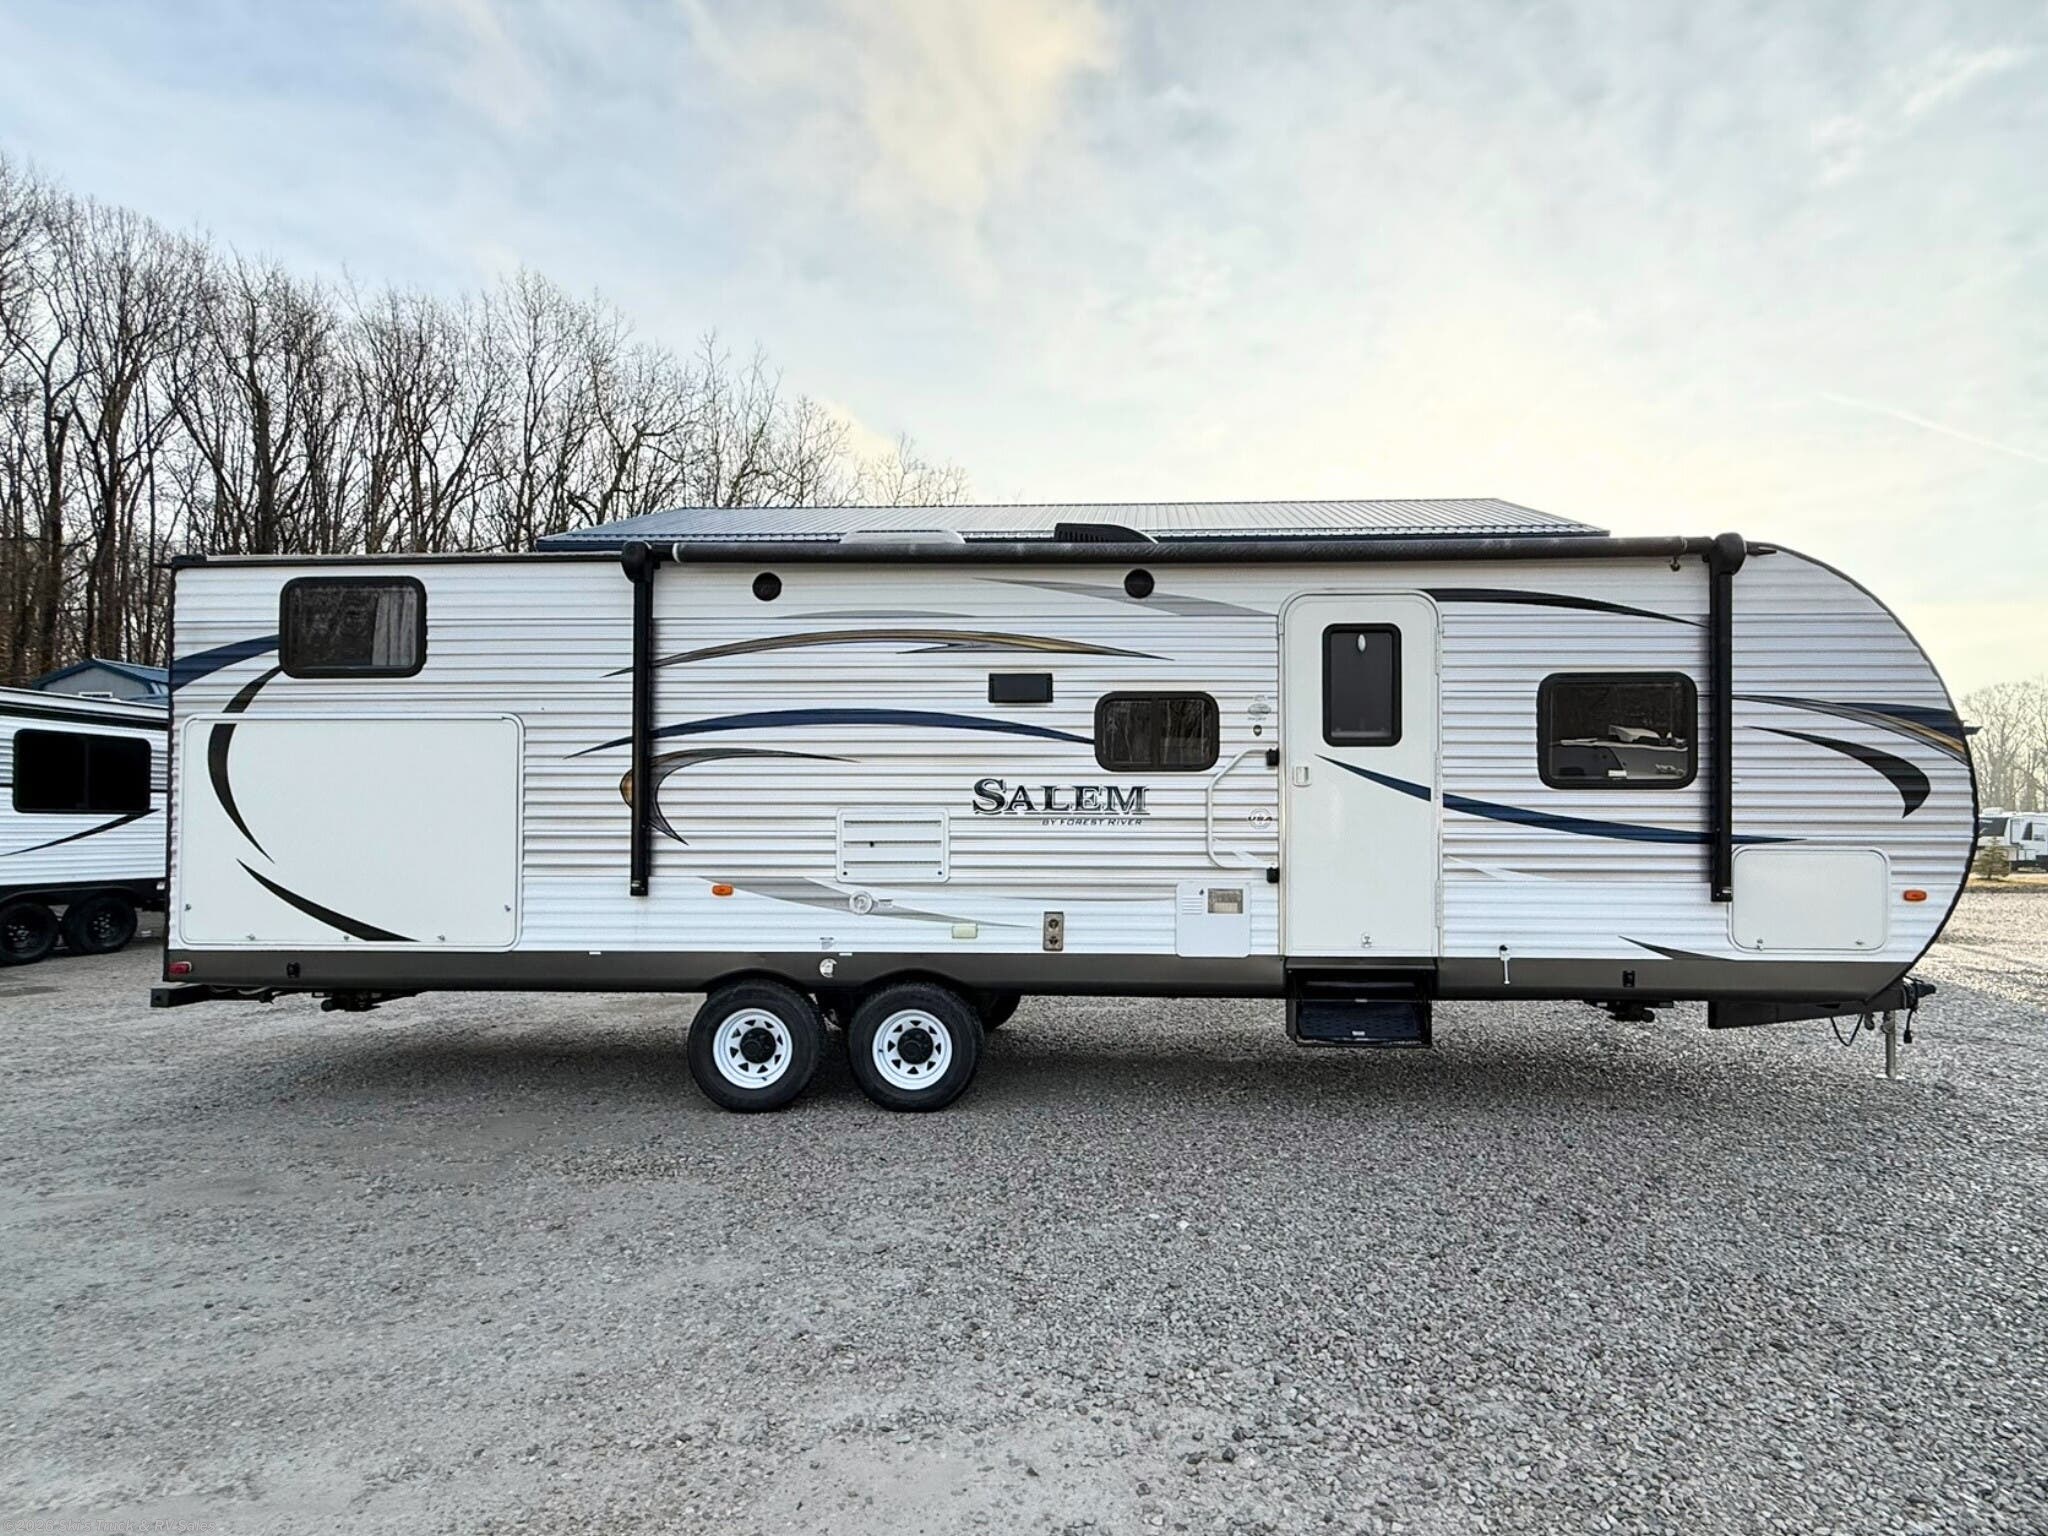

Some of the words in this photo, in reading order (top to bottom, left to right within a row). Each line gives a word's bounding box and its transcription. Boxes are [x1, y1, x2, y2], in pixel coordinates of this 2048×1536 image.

[972, 778, 1150, 815] SALEM
[1042, 818, 1057, 826] BY
[1059, 818, 1105, 826] FOREST
[1107, 818, 1143, 826] RIVER
